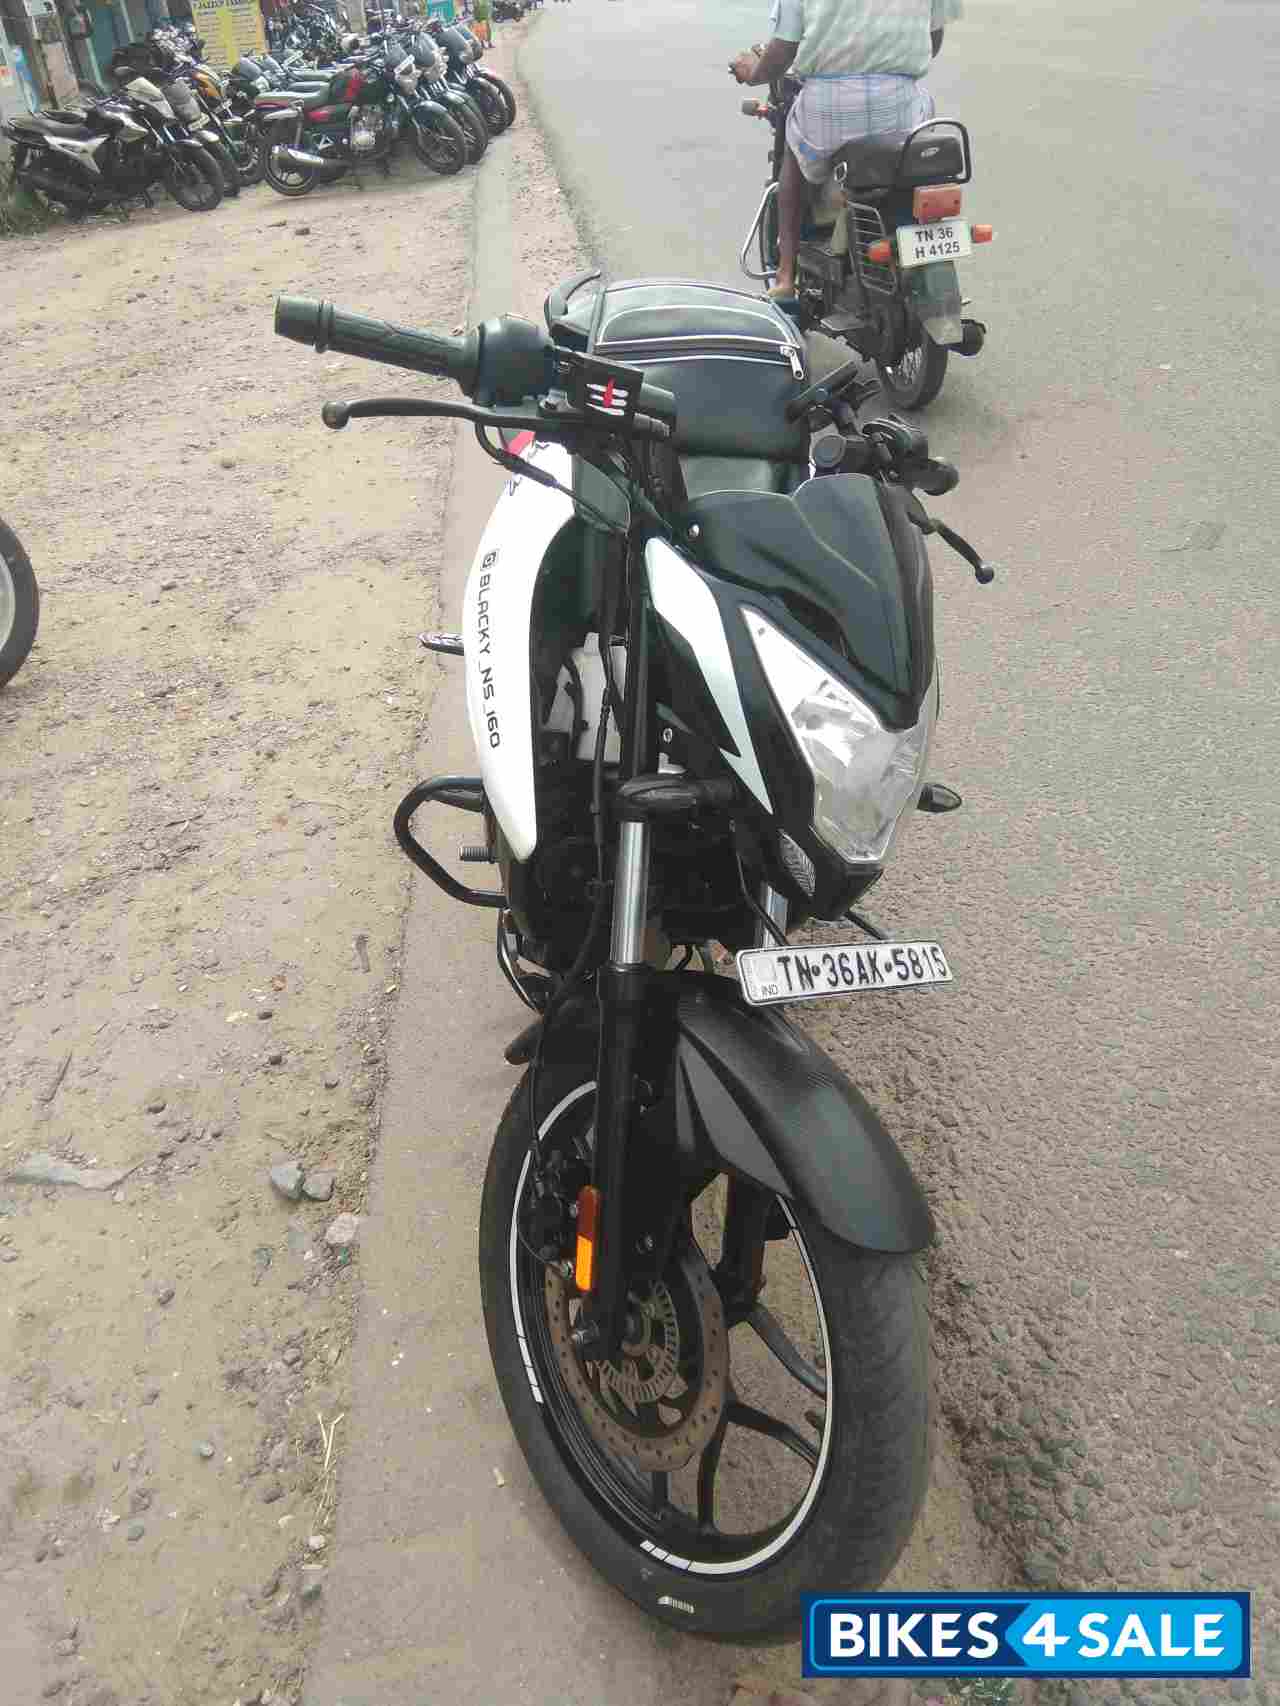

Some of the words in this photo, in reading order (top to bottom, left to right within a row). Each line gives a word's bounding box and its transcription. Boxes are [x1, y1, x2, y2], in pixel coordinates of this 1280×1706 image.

[915, 229, 935, 243] TN
[937, 226, 953, 240] 36
[915, 246, 926, 259] H
[929, 241, 960, 256] 4125
[890, 947, 947, 981] 5815
